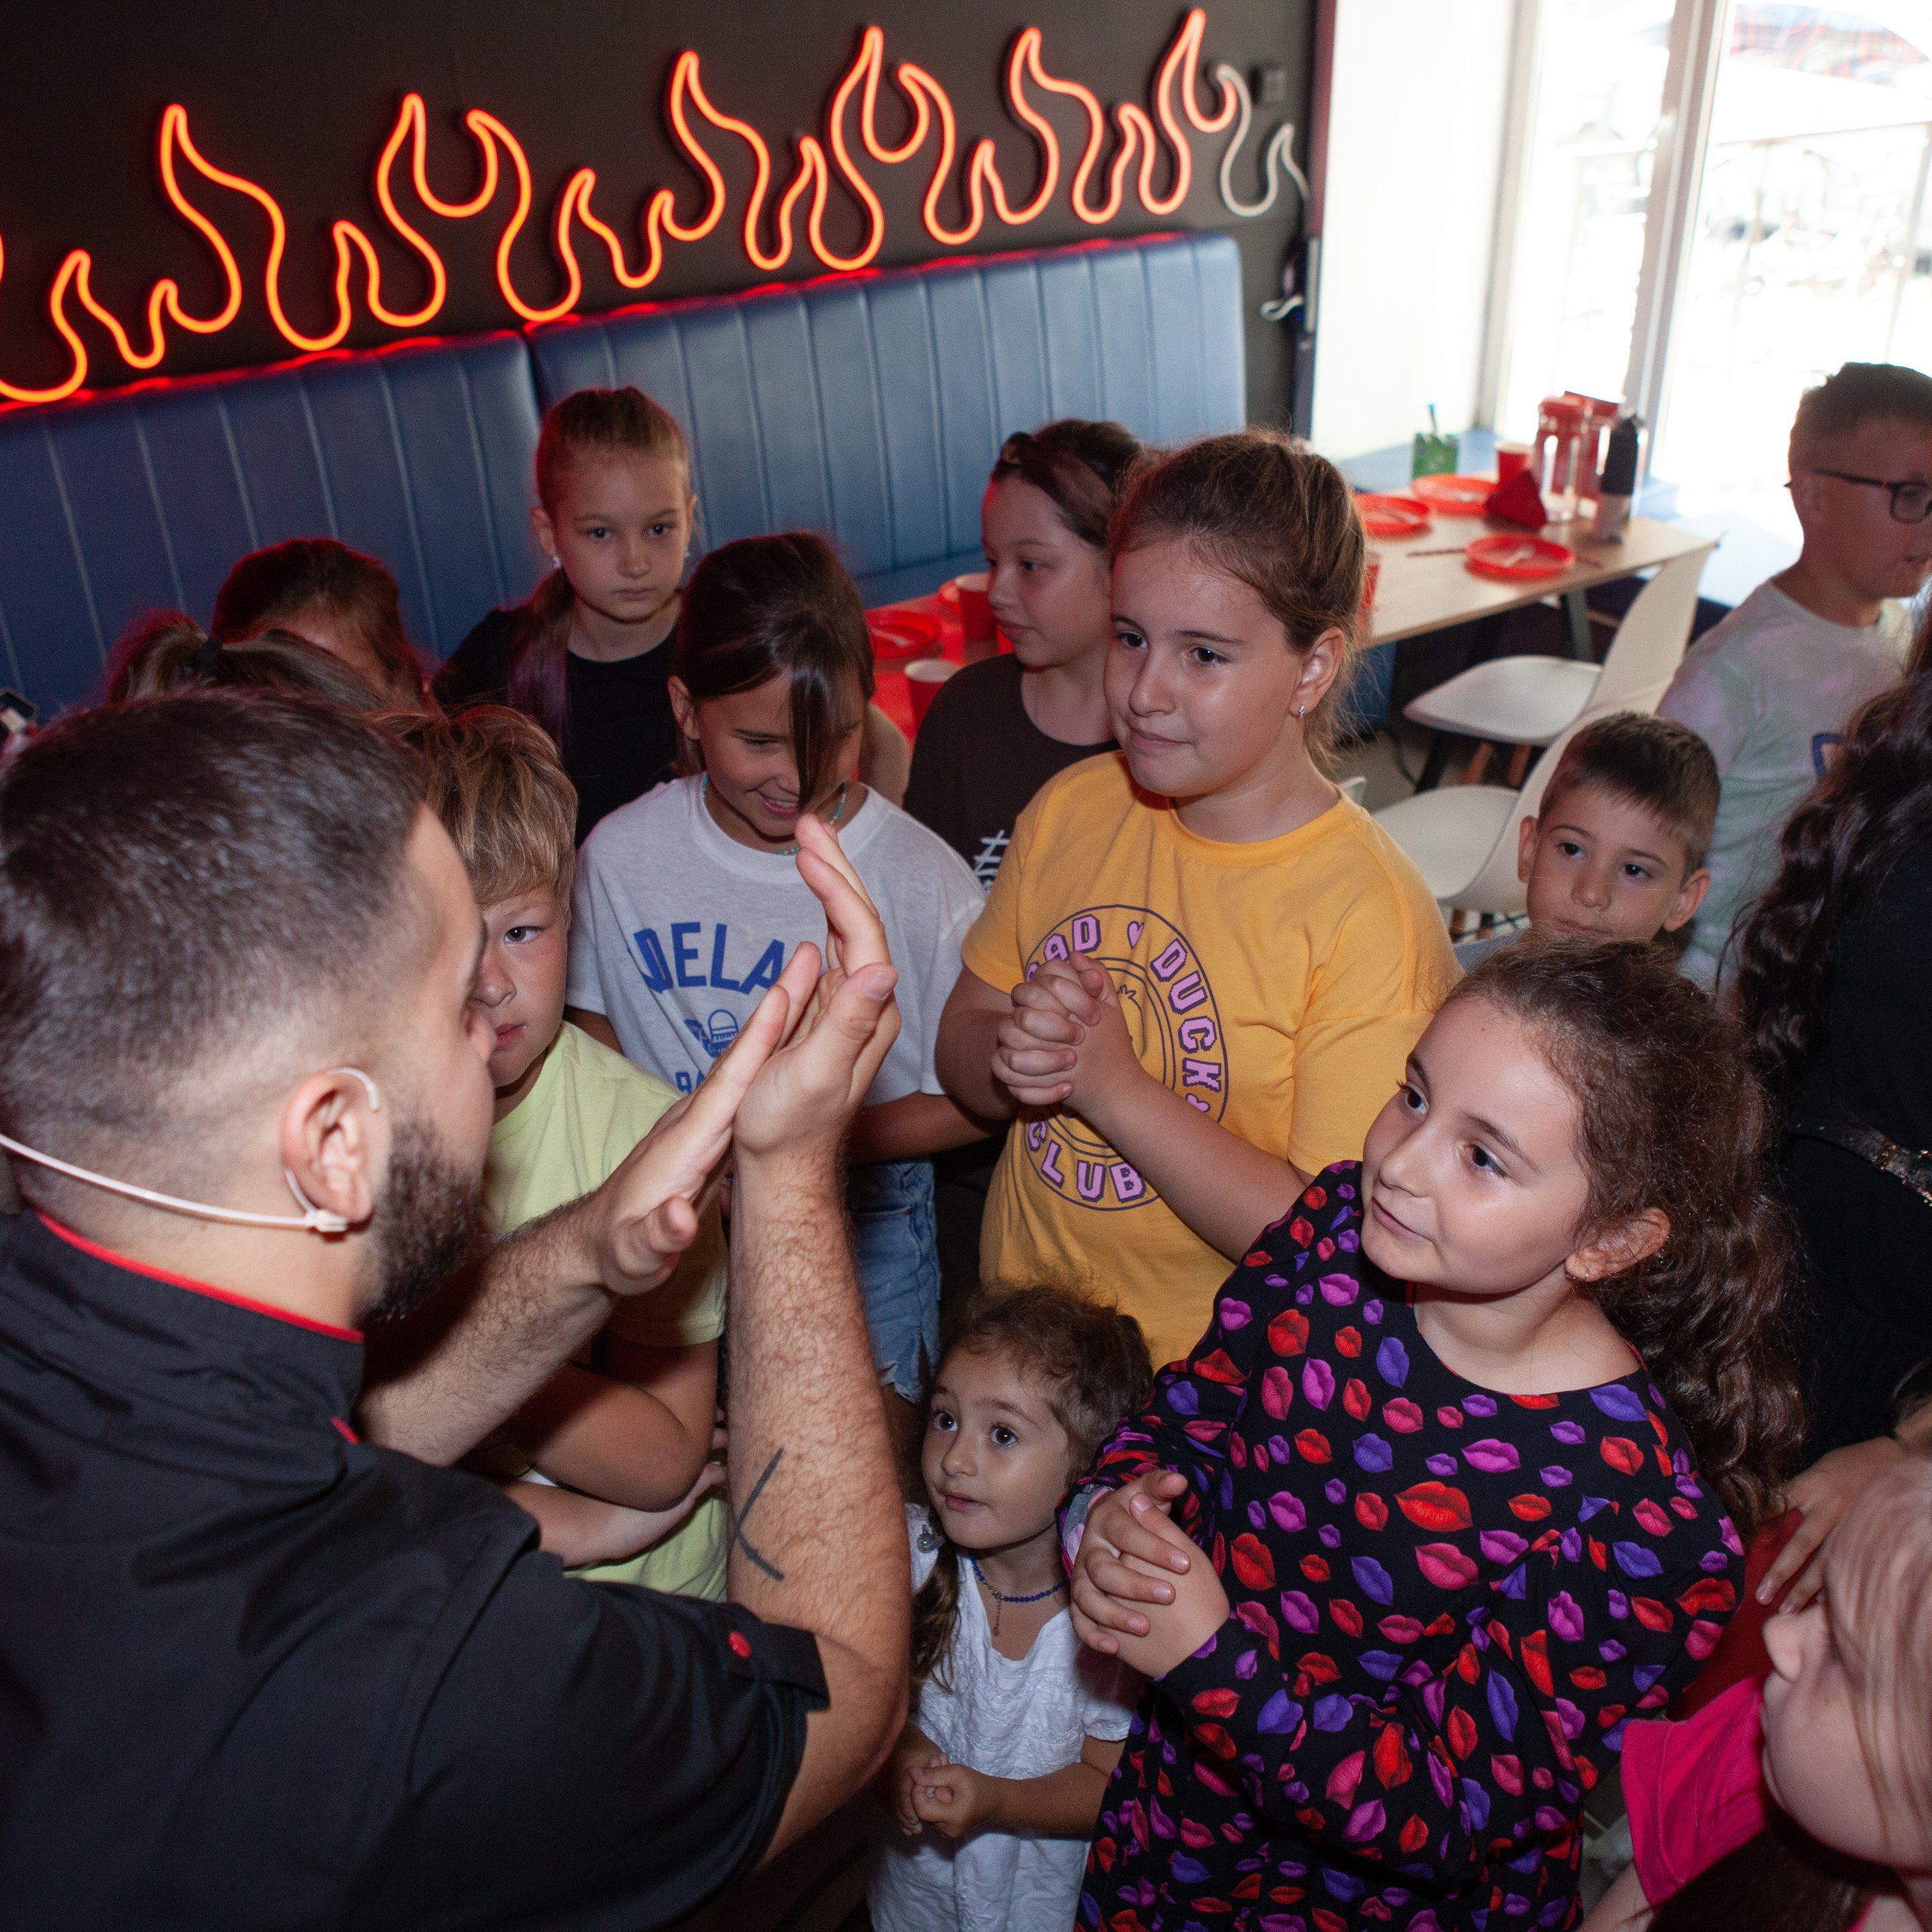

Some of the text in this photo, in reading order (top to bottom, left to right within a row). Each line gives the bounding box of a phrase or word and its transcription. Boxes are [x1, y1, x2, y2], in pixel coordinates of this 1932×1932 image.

[632, 921, 786, 995] DELA
[1150, 938, 1222, 1093] DUCK
[1027, 1113, 1146, 1203] CLUB
